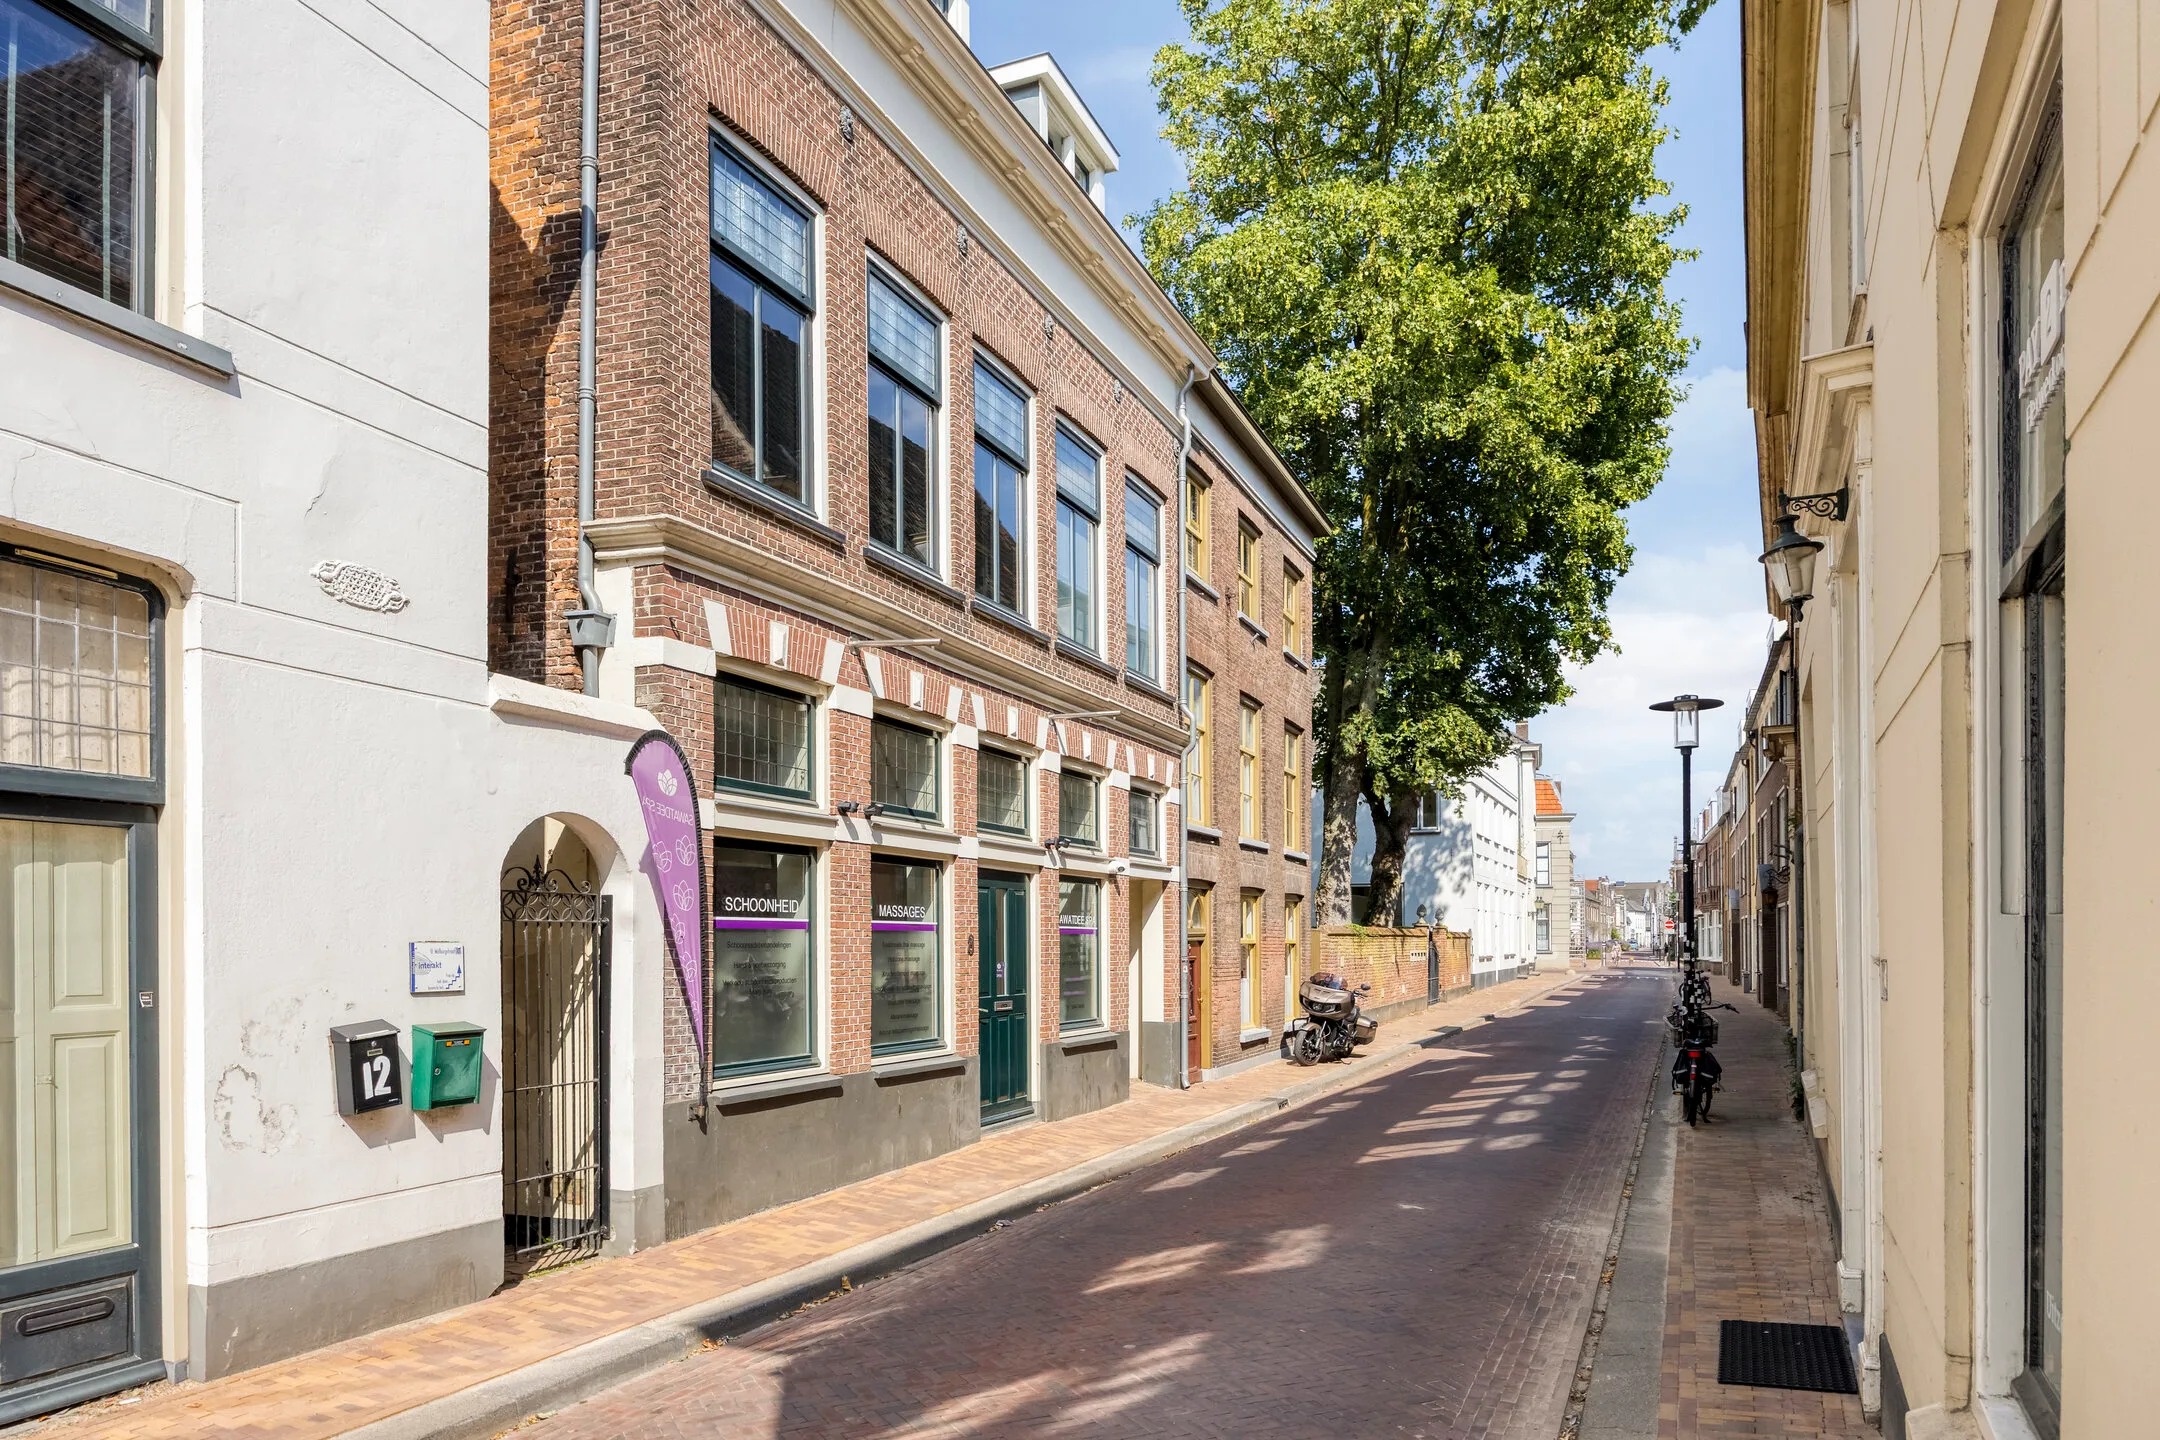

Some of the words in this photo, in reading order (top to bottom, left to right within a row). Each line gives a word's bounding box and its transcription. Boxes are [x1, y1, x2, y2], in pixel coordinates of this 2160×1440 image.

[725, 896, 799, 913] SCHOONHEID
[878, 904, 926, 918] MASSAGES
[1060, 914, 1085, 925] AWATDEE
[363, 1055, 391, 1100] 12
